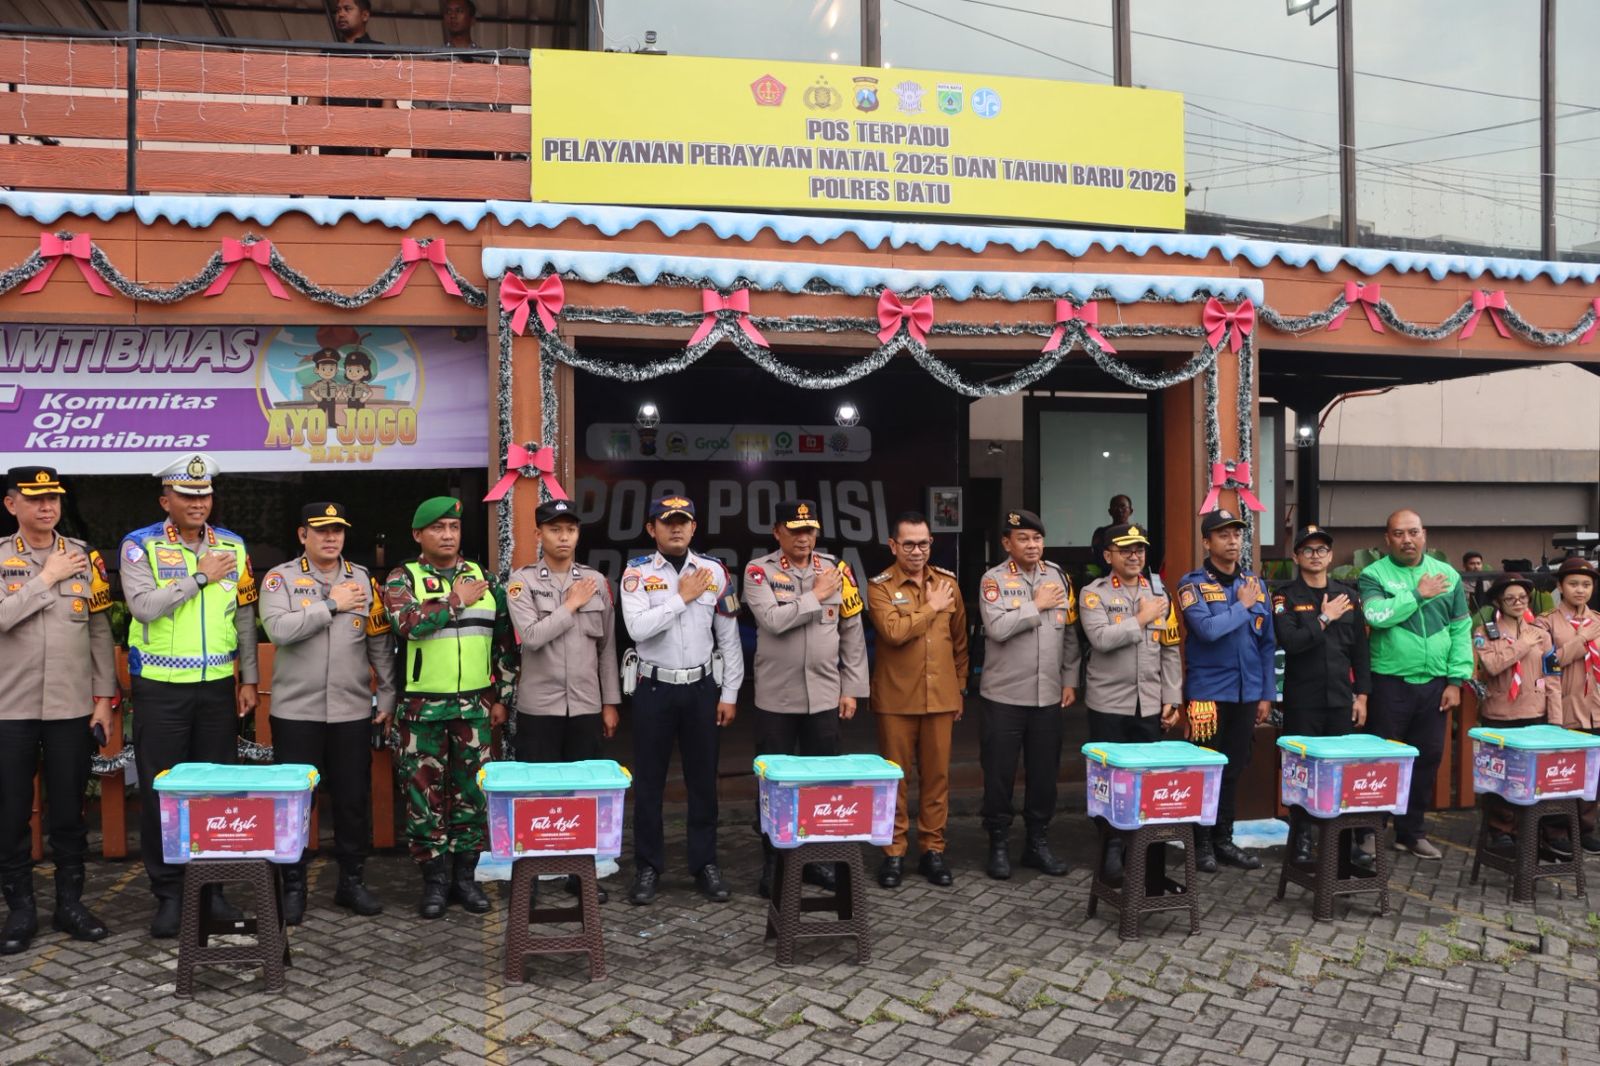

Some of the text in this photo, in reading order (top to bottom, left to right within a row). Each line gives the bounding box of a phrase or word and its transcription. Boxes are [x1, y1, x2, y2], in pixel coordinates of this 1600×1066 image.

[806, 118, 950, 148] POS TERPADU
[542, 137, 1177, 193] PELAYANAN PERAYAAN NATAL 2025 DAN TAHUN BARU 2026
[808, 175, 951, 205] POLRES BATU
[0, 327, 259, 373] MTIBMAS
[39, 392, 217, 410] Komunitas
[33, 412, 104, 433] Ojol
[264, 408, 417, 447] AYO JOGO
[24, 431, 210, 449] Kamtibmas
[695, 436, 730, 450] Grab
[310, 446, 375, 464] BATU
[2, 569, 31, 578] JIMMY
[1003, 589, 1026, 597] BUDI
[813, 802, 858, 818] Tali Asih
[206, 815, 257, 832] Tali Asih
[530, 814, 580, 832] Tali Asih
